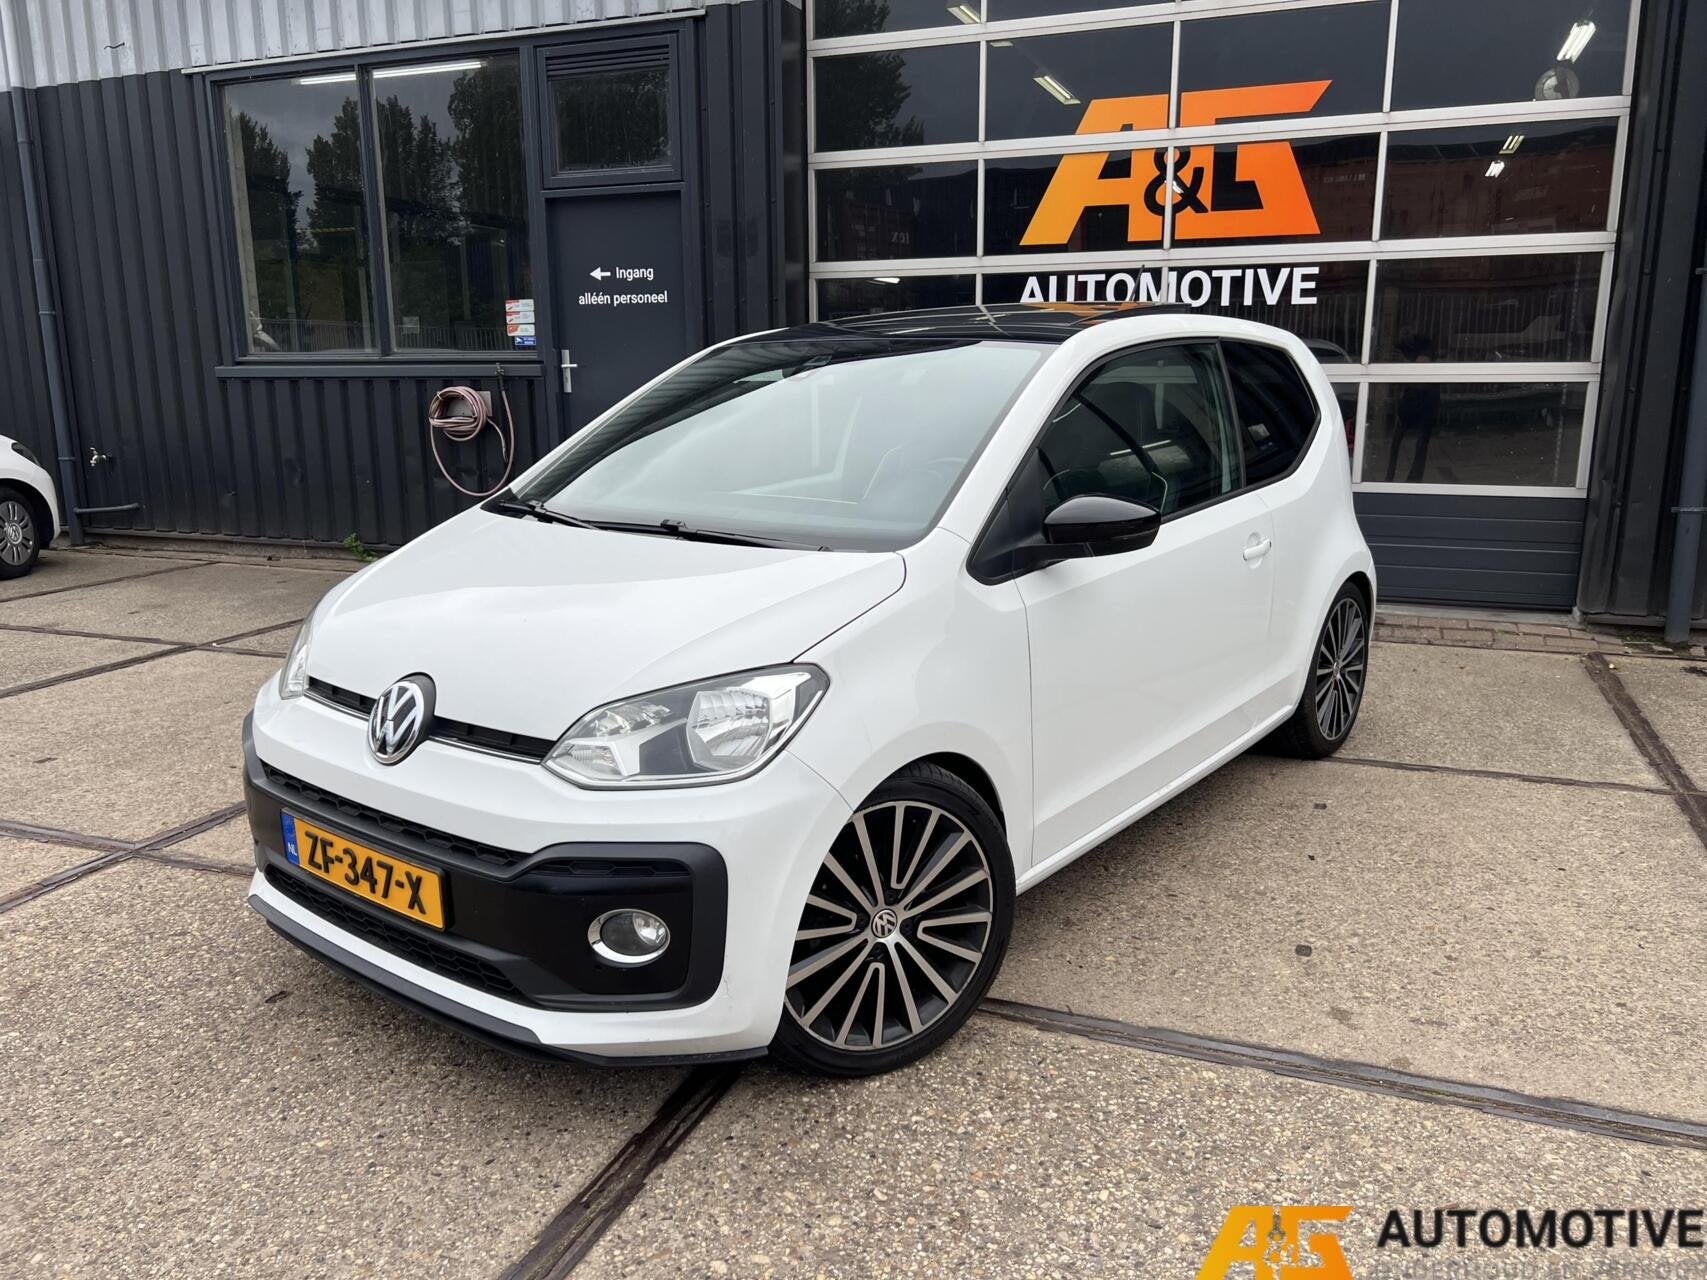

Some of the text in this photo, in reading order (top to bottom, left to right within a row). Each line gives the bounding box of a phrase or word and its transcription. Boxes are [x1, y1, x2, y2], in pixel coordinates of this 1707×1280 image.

[615, 266, 654, 281] Ingang
[1019, 266, 1320, 307] AUTOMOTIVE
[578, 290, 668, 307] alléén personeel
[287, 842, 298, 856] NL
[304, 830, 427, 915] ZF-347-X
